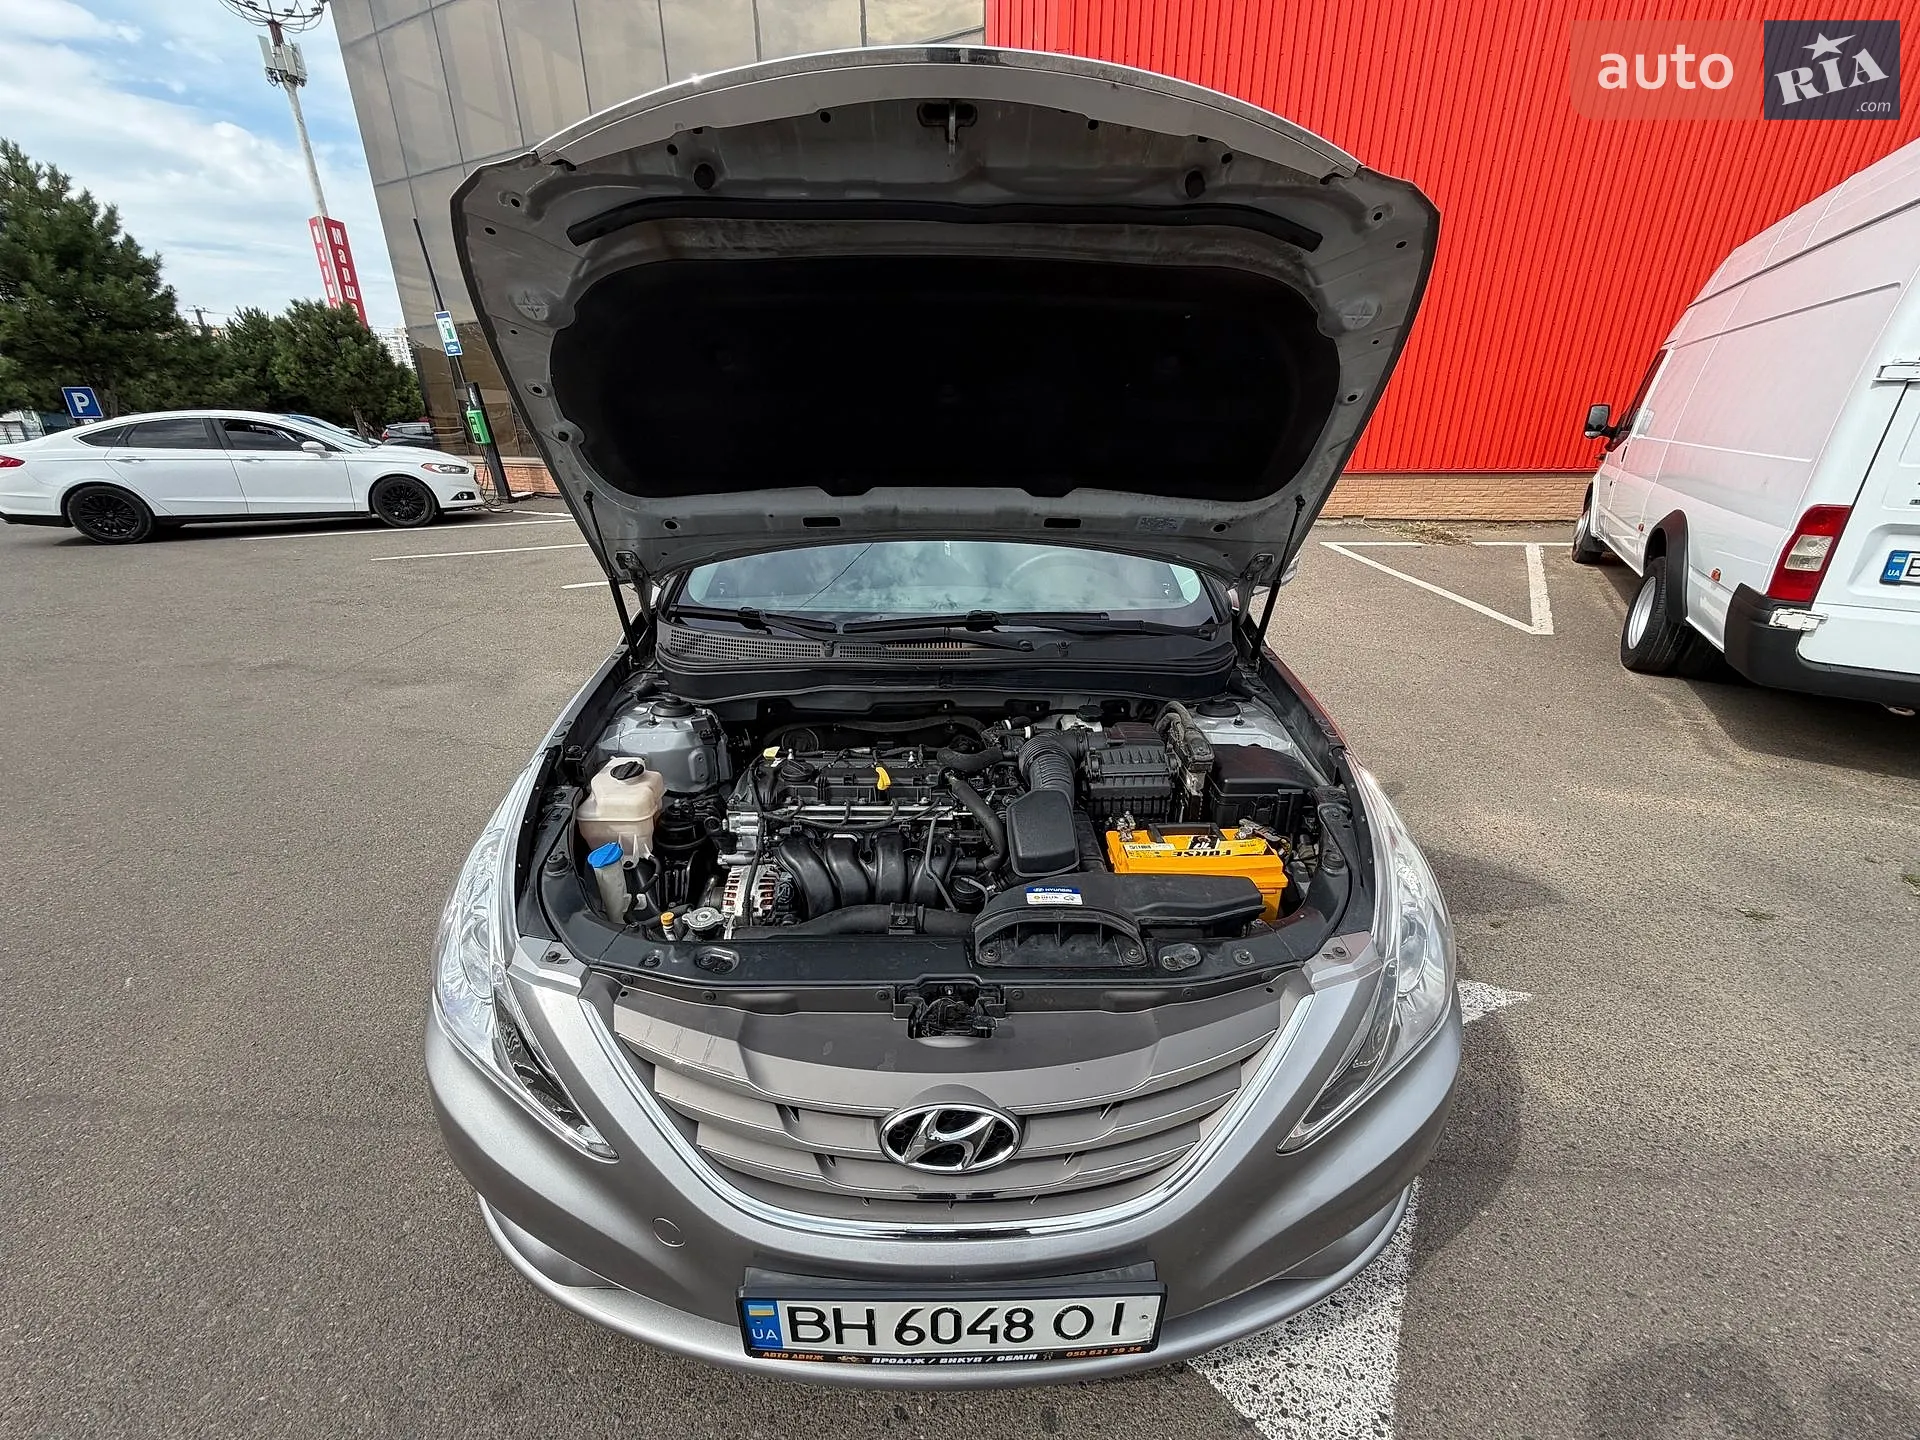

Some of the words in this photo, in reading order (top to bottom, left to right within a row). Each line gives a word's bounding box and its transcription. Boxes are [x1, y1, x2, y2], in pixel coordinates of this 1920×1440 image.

[71, 392, 89, 413] P
[786, 1306, 876, 1346] BH
[894, 1307, 1034, 1346] 6048
[752, 1328, 778, 1342] UA
[939, 1356, 982, 1364] ВИКУП
[997, 1353, 1038, 1361] ОБМІН
